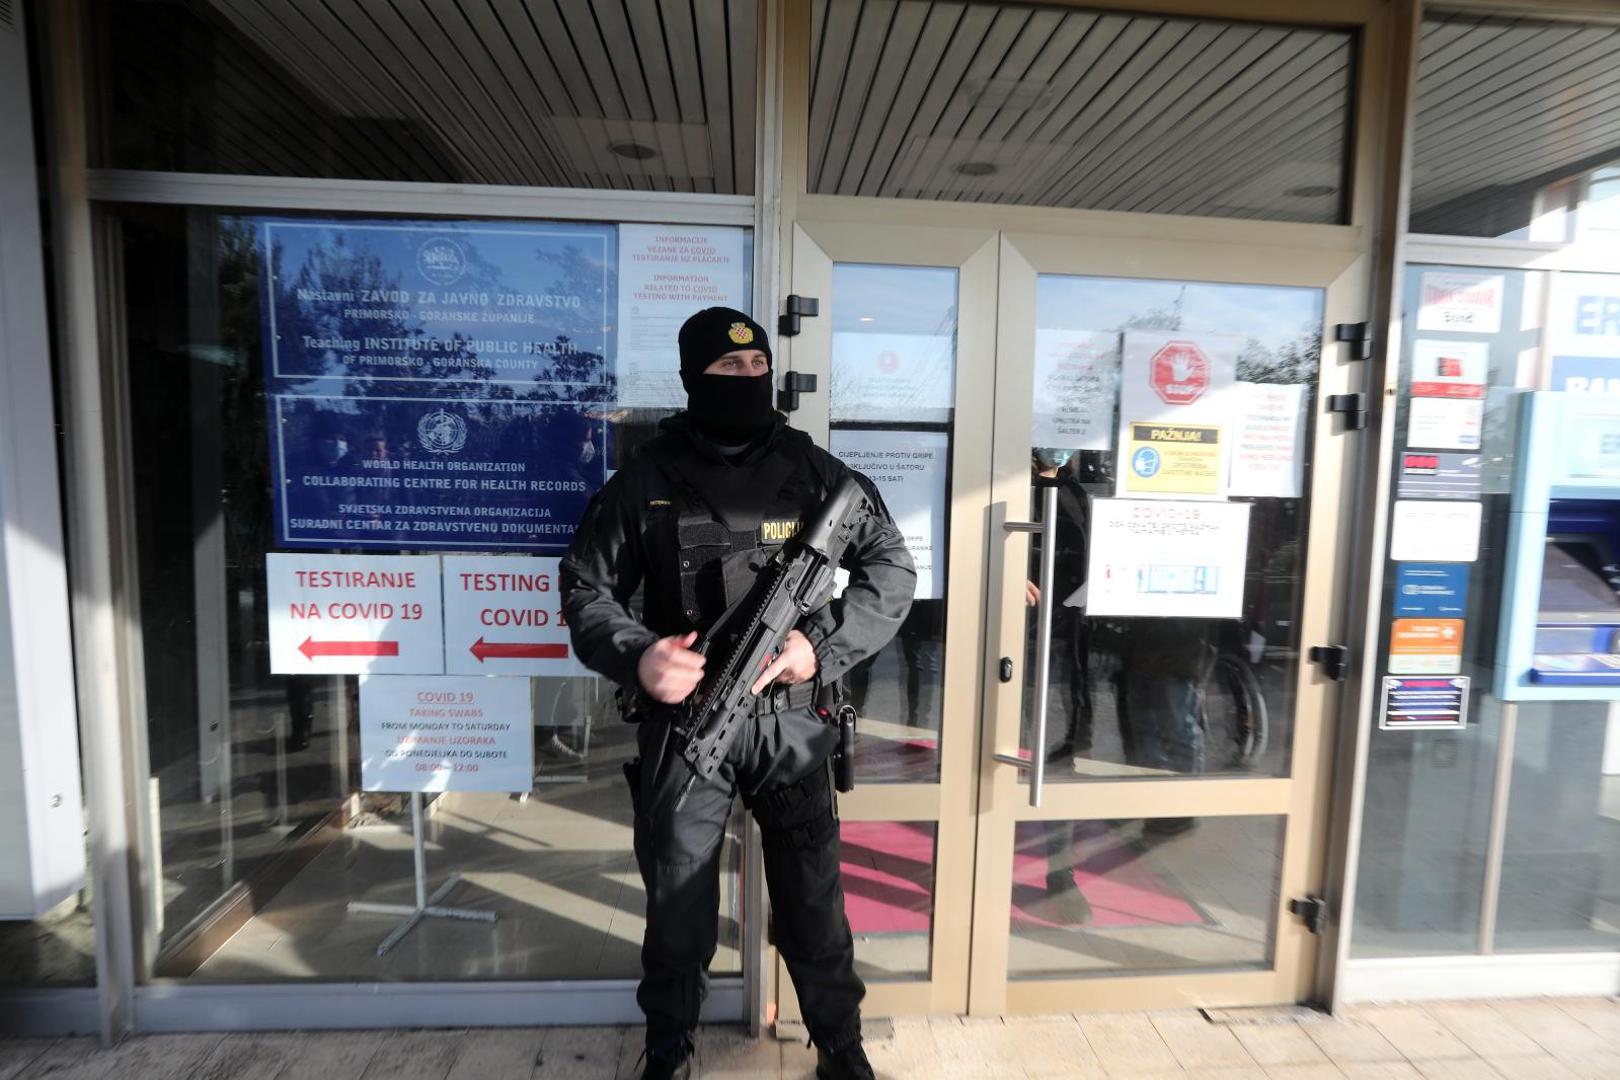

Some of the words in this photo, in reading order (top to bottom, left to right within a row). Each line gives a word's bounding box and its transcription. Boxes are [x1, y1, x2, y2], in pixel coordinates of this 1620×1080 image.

[655, 235, 707, 244] INFORMACIJE
[648, 246, 676, 254] VEZANE
[691, 247, 716, 256] COVID
[632, 254, 678, 262] TESTIRANJE
[654, 274, 709, 283] INFORMATION
[644, 284, 679, 292] RELATED
[693, 286, 718, 294] COVID
[297, 289, 354, 301] Nastavni
[361, 289, 410, 303] ZAVOD
[418, 291, 437, 304] ZA
[441, 291, 489, 305] JAVNO
[497, 294, 581, 308] ZDRAVSTVO
[634, 293, 668, 301] TESTING
[669, 293, 691, 301] WITH
[692, 294, 728, 302] PAYMENT
[344, 308, 410, 320] PRIMORSKO
[419, 310, 478, 322] GORANSKE
[302, 335, 360, 351] Teaching
[364, 337, 439, 351] INSTITUTE
[443, 339, 462, 352] OF
[465, 339, 518, 353] PUBLIC
[522, 341, 578, 355] HEALTH
[343, 355, 357, 366] OF
[359, 355, 424, 367] PRIMORSKO
[433, 357, 493, 369] GORANSKA
[496, 358, 538, 370] COUNTY
[838, 451, 884, 459] CIJEPLJENJE
[912, 452, 933, 460] GRIPE
[362, 459, 400, 470] WORLD
[403, 460, 445, 471] HEALTH
[447, 461, 526, 473] ORGANIZATION
[850, 462, 889, 470] SKLJUČIVO
[896, 462, 925, 471] ŠATORU
[303, 475, 401, 488] COLLABORATING
[403, 477, 451, 490] CENTRE
[454, 477, 478, 490] FOR
[480, 478, 527, 491] HEALTH
[530, 479, 586, 492] RECORDS
[338, 503, 392, 515] SVJETSKA
[395, 504, 471, 516] ZDRAVSTVENA
[473, 506, 552, 518] ORGANIZACIJA
[289, 518, 343, 530] SURADNI
[346, 519, 392, 531] CENTAR
[394, 520, 411, 532] ZA
[413, 520, 499, 533] ZDRAVSTVENU
[501, 522, 579, 535] DOKUMENTA
[296, 571, 417, 588] TESTIRANJE
[460, 573, 550, 593] TESTING
[290, 603, 321, 620] NA
[328, 603, 394, 620] COVID
[401, 604, 424, 620] 19
[480, 608, 549, 627] COVID
[556, 609, 568, 627] 1
[417, 691, 456, 702] COVID
[460, 692, 474, 703] 19
[410, 708, 446, 717] TAKING
[448, 709, 484, 718] SWABS
[381, 721, 408, 730] FROM
[409, 722, 449, 730] MONDAY
[452, 722, 464, 731] TO
[466, 722, 511, 731] SATURDAY
[449, 736, 496, 745] UZORAKA
[460, 750, 473, 759] DO
[475, 750, 507, 759] SUBOTE
[453, 763, 479, 773] 12:00
